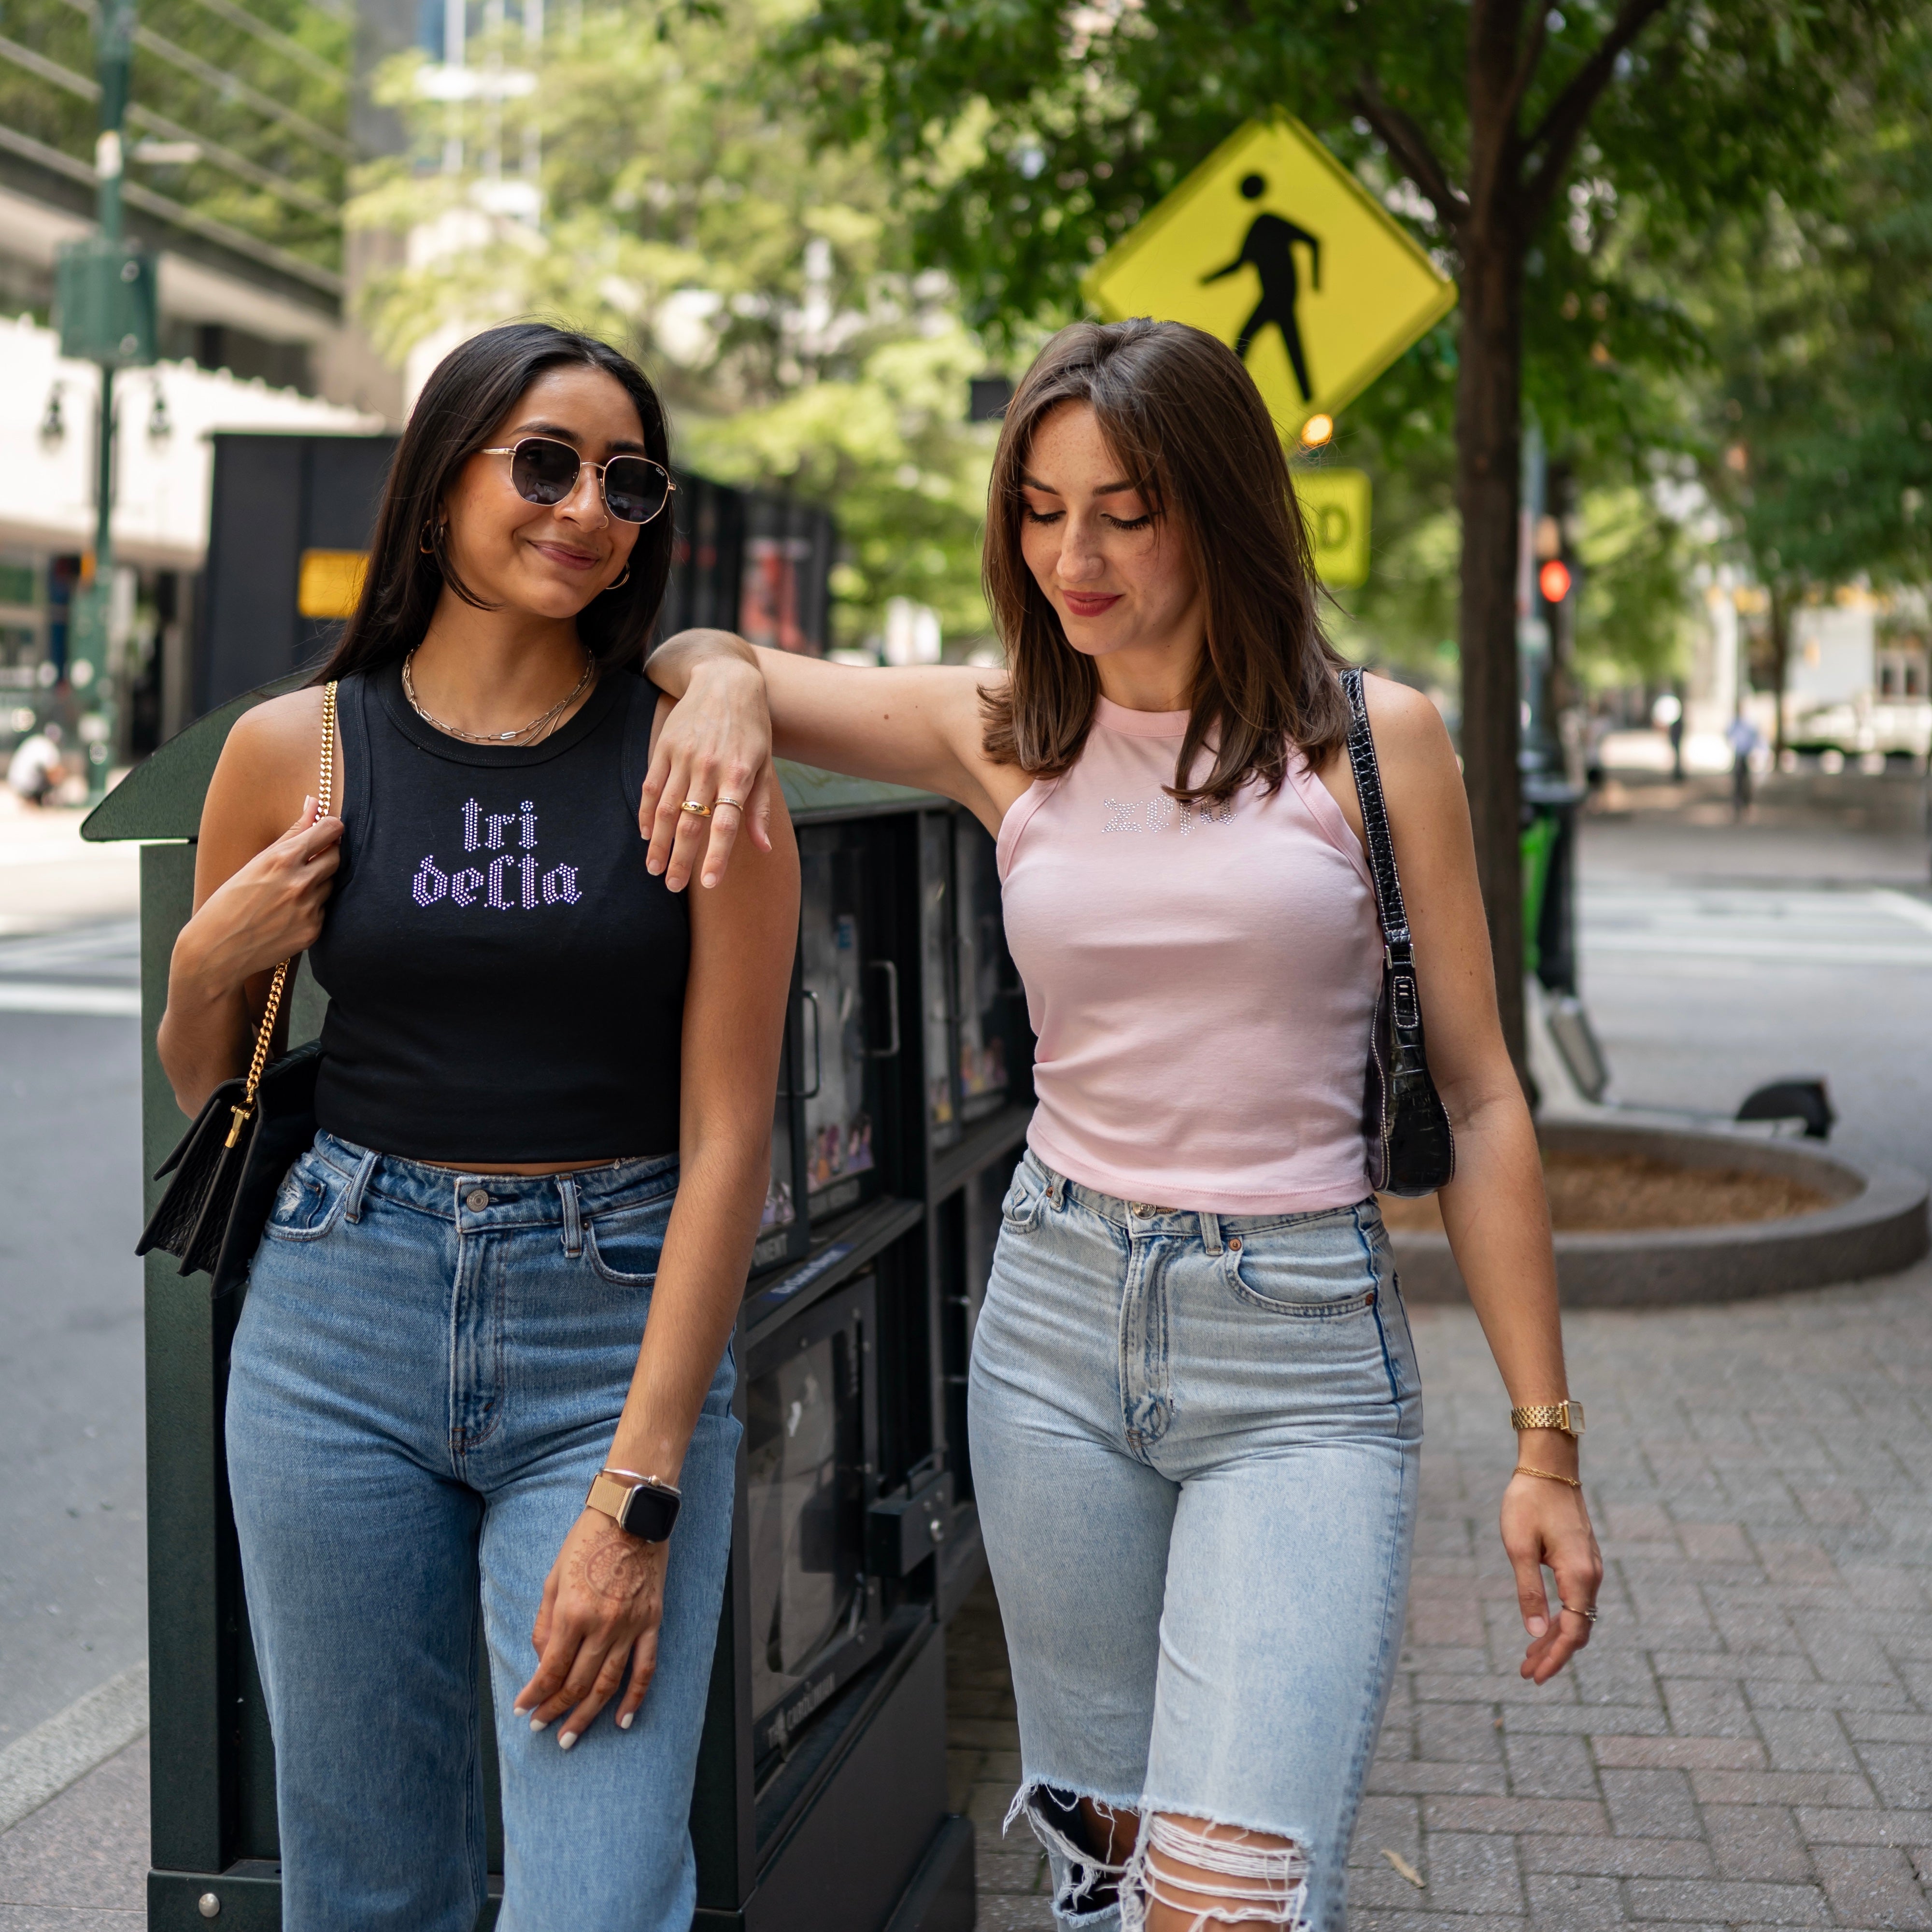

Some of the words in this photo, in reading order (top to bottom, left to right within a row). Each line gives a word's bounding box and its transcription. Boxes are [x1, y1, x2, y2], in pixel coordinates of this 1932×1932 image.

[655, 467, 666, 477] QUAY
[461, 798, 538, 852] tri
[412, 853, 582, 910] delta
